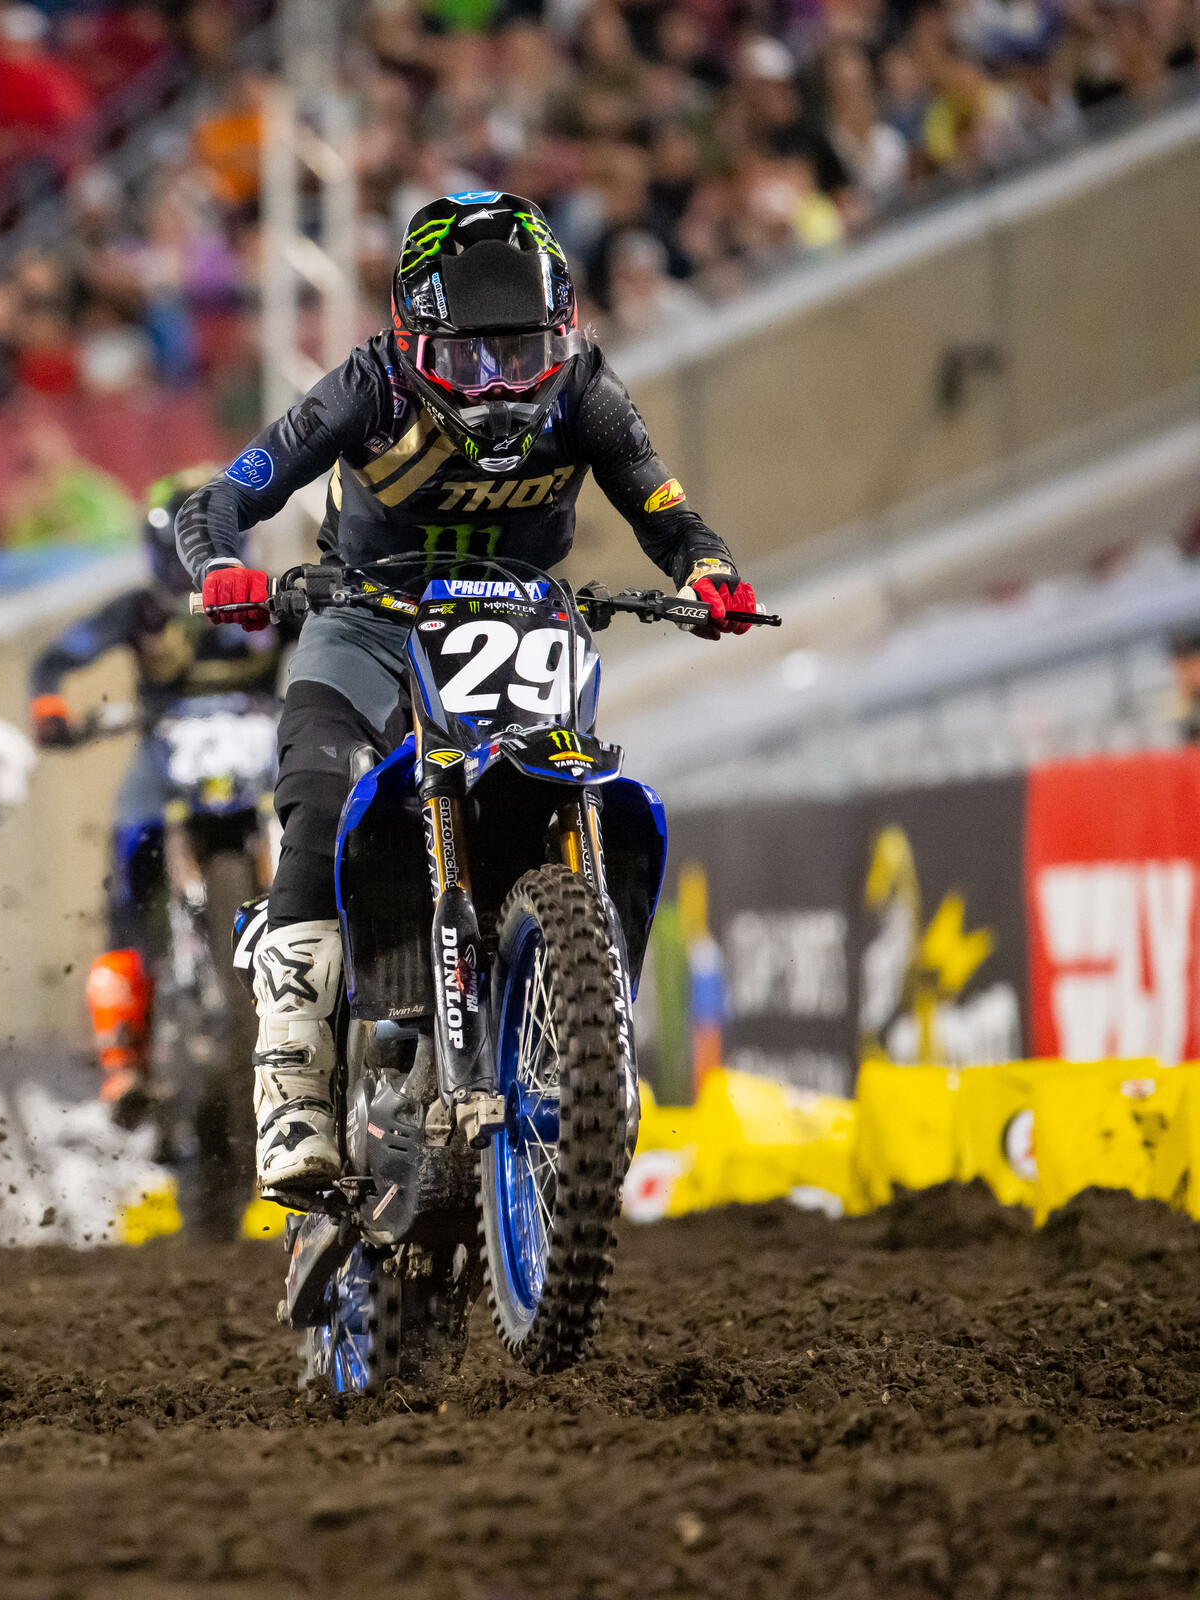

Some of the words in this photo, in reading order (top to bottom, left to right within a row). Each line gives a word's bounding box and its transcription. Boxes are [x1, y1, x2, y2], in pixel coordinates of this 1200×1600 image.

[666, 605, 708, 618] ARC
[439, 620, 586, 714] 29
[554, 759, 592, 769] YAMAHA
[442, 925, 464, 1049] DUNLOP
[388, 1007, 410, 1016] Twin
[412, 1004, 425, 1013] Air
